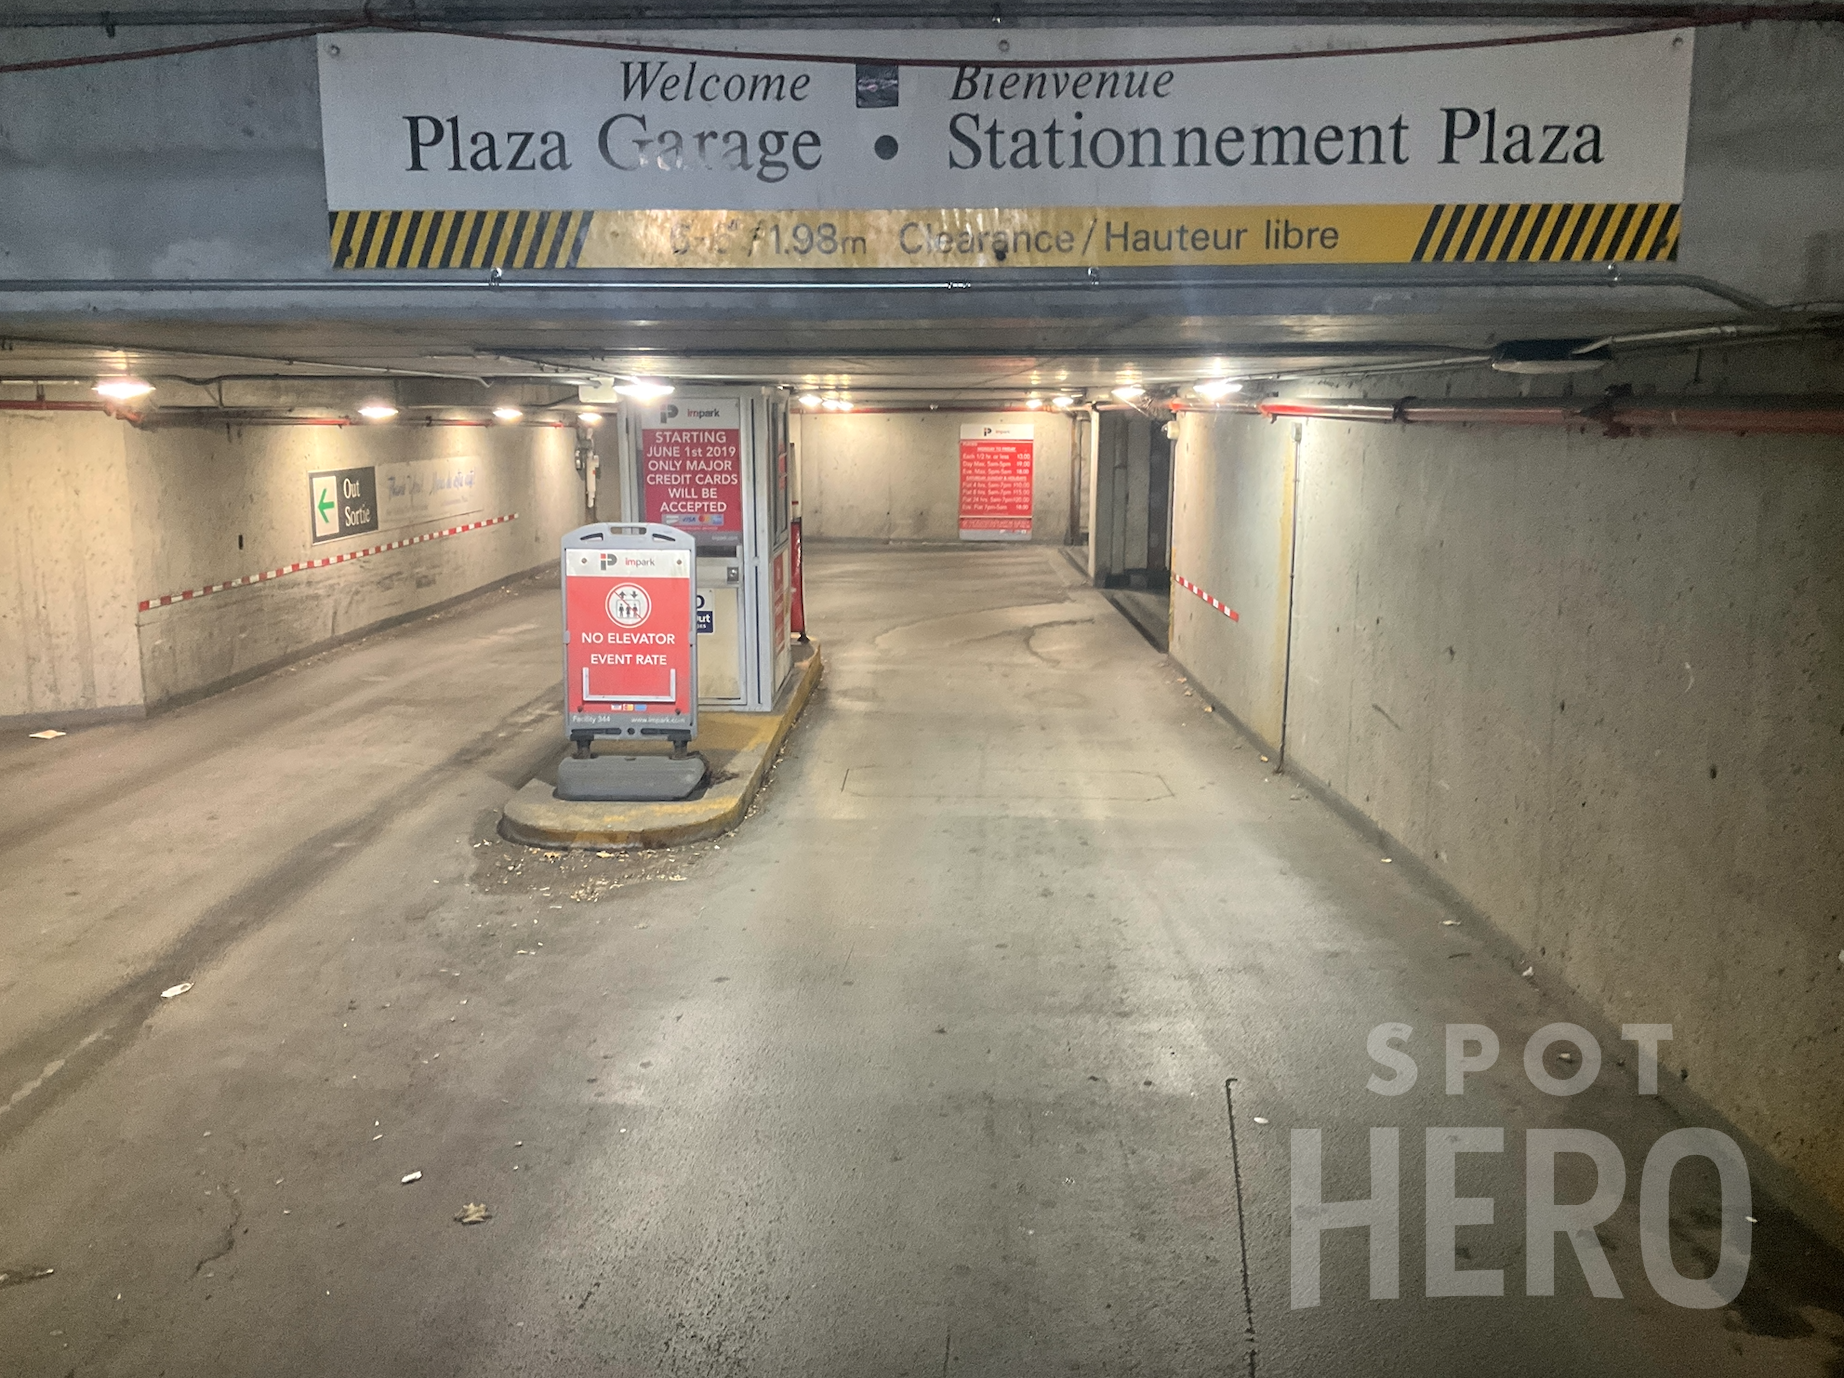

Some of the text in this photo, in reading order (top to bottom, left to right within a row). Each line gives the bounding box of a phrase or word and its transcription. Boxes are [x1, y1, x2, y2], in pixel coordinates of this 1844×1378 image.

[620, 61, 811, 102] Welcome
[950, 65, 1175, 101] Bienvenue
[948, 107, 1604, 170] Stationnement Plaza
[402, 113, 822, 183] Plaza Garage
[1265, 218, 1340, 250] libre
[655, 431, 727, 444] STARTING
[647, 446, 737, 458] JUNE 1st 2019
[648, 460, 732, 471] ONLY MAJOR
[646, 474, 738, 485] CREDIT CARDS
[343, 477, 361, 500] Out
[668, 488, 718, 499] WILL BE
[659, 501, 727, 512] ACCEPTED
[344, 502, 371, 527] Sortie
[625, 557, 655, 568] impark
[581, 632, 676, 645] NO ELEVATOR
[590, 654, 667, 666] EVENT RATE
